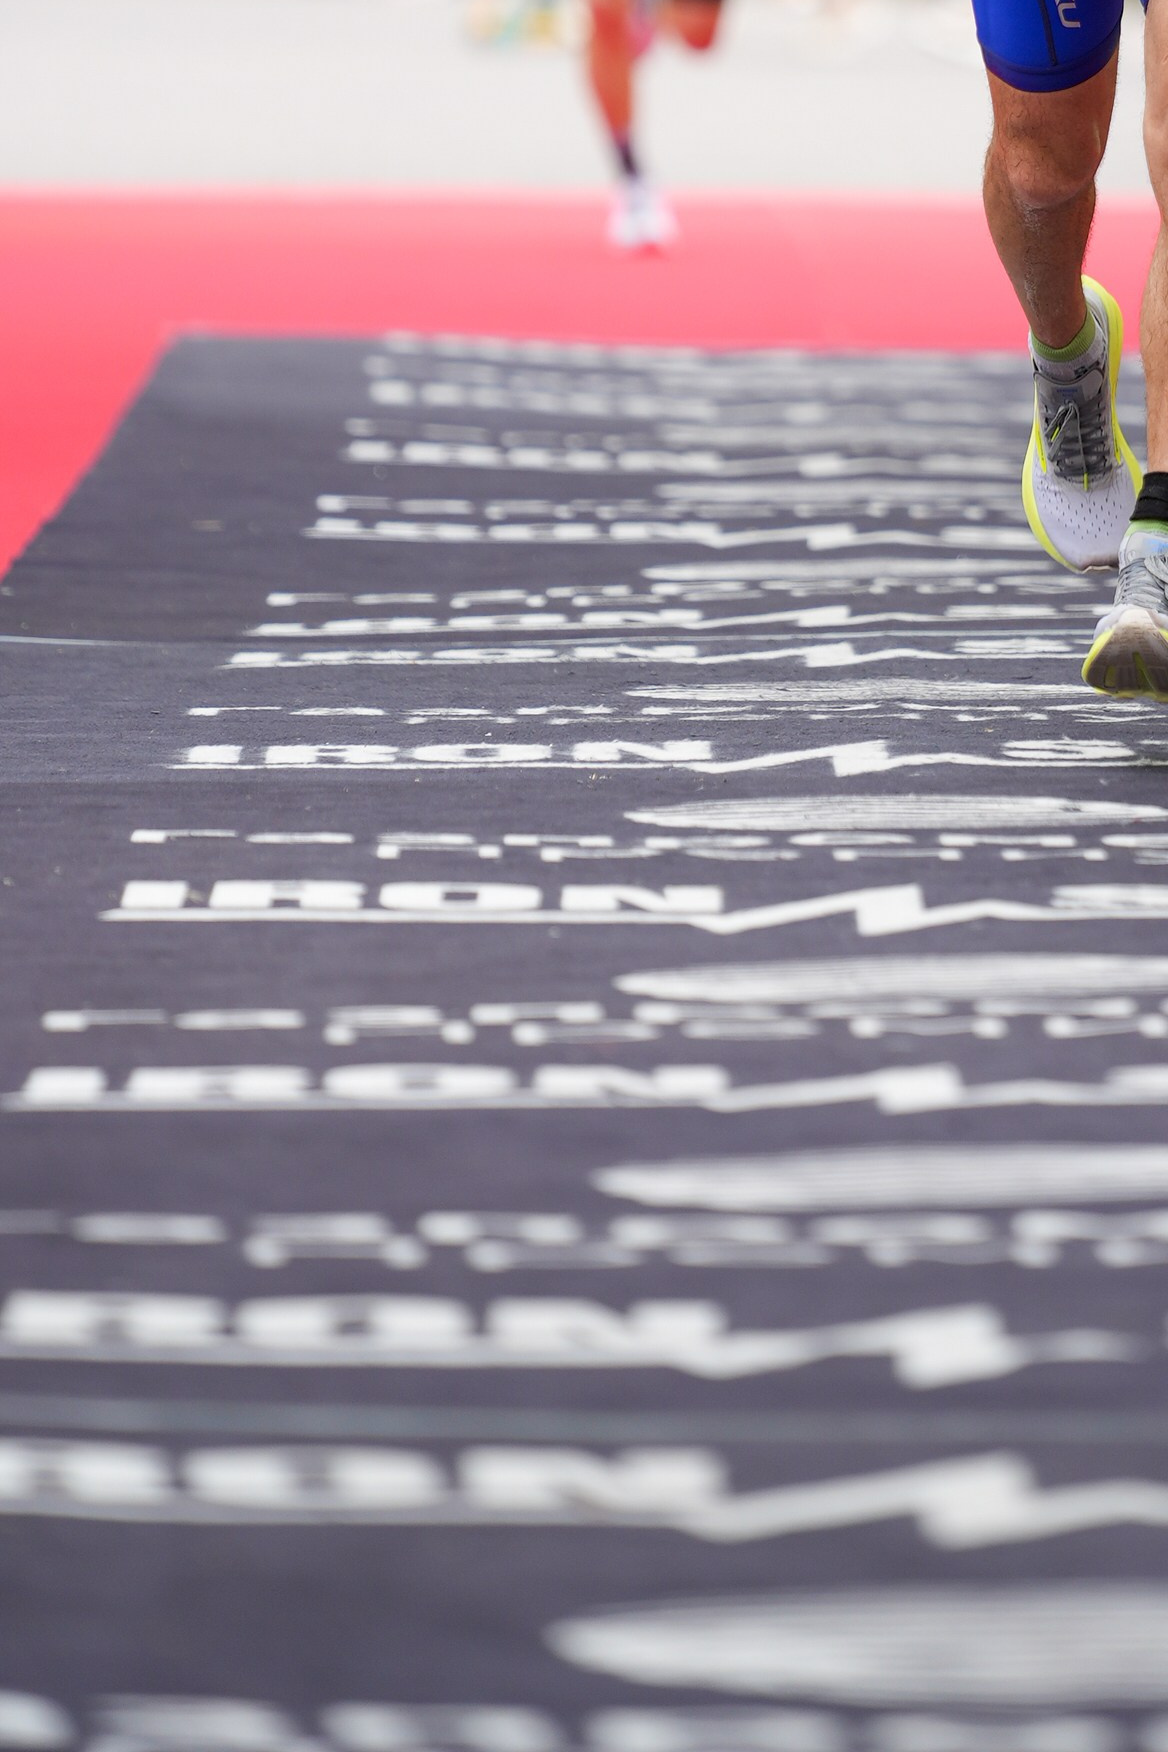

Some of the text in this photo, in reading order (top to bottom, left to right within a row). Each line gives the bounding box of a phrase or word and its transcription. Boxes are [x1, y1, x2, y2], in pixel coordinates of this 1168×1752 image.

[229, 645, 700, 663] IRON
[185, 740, 712, 764] IRON
[119, 880, 725, 910] IRON
[23, 1063, 728, 1102] IRON
[0, 1291, 725, 1350] RON
[0, 1438, 727, 1510] RON
